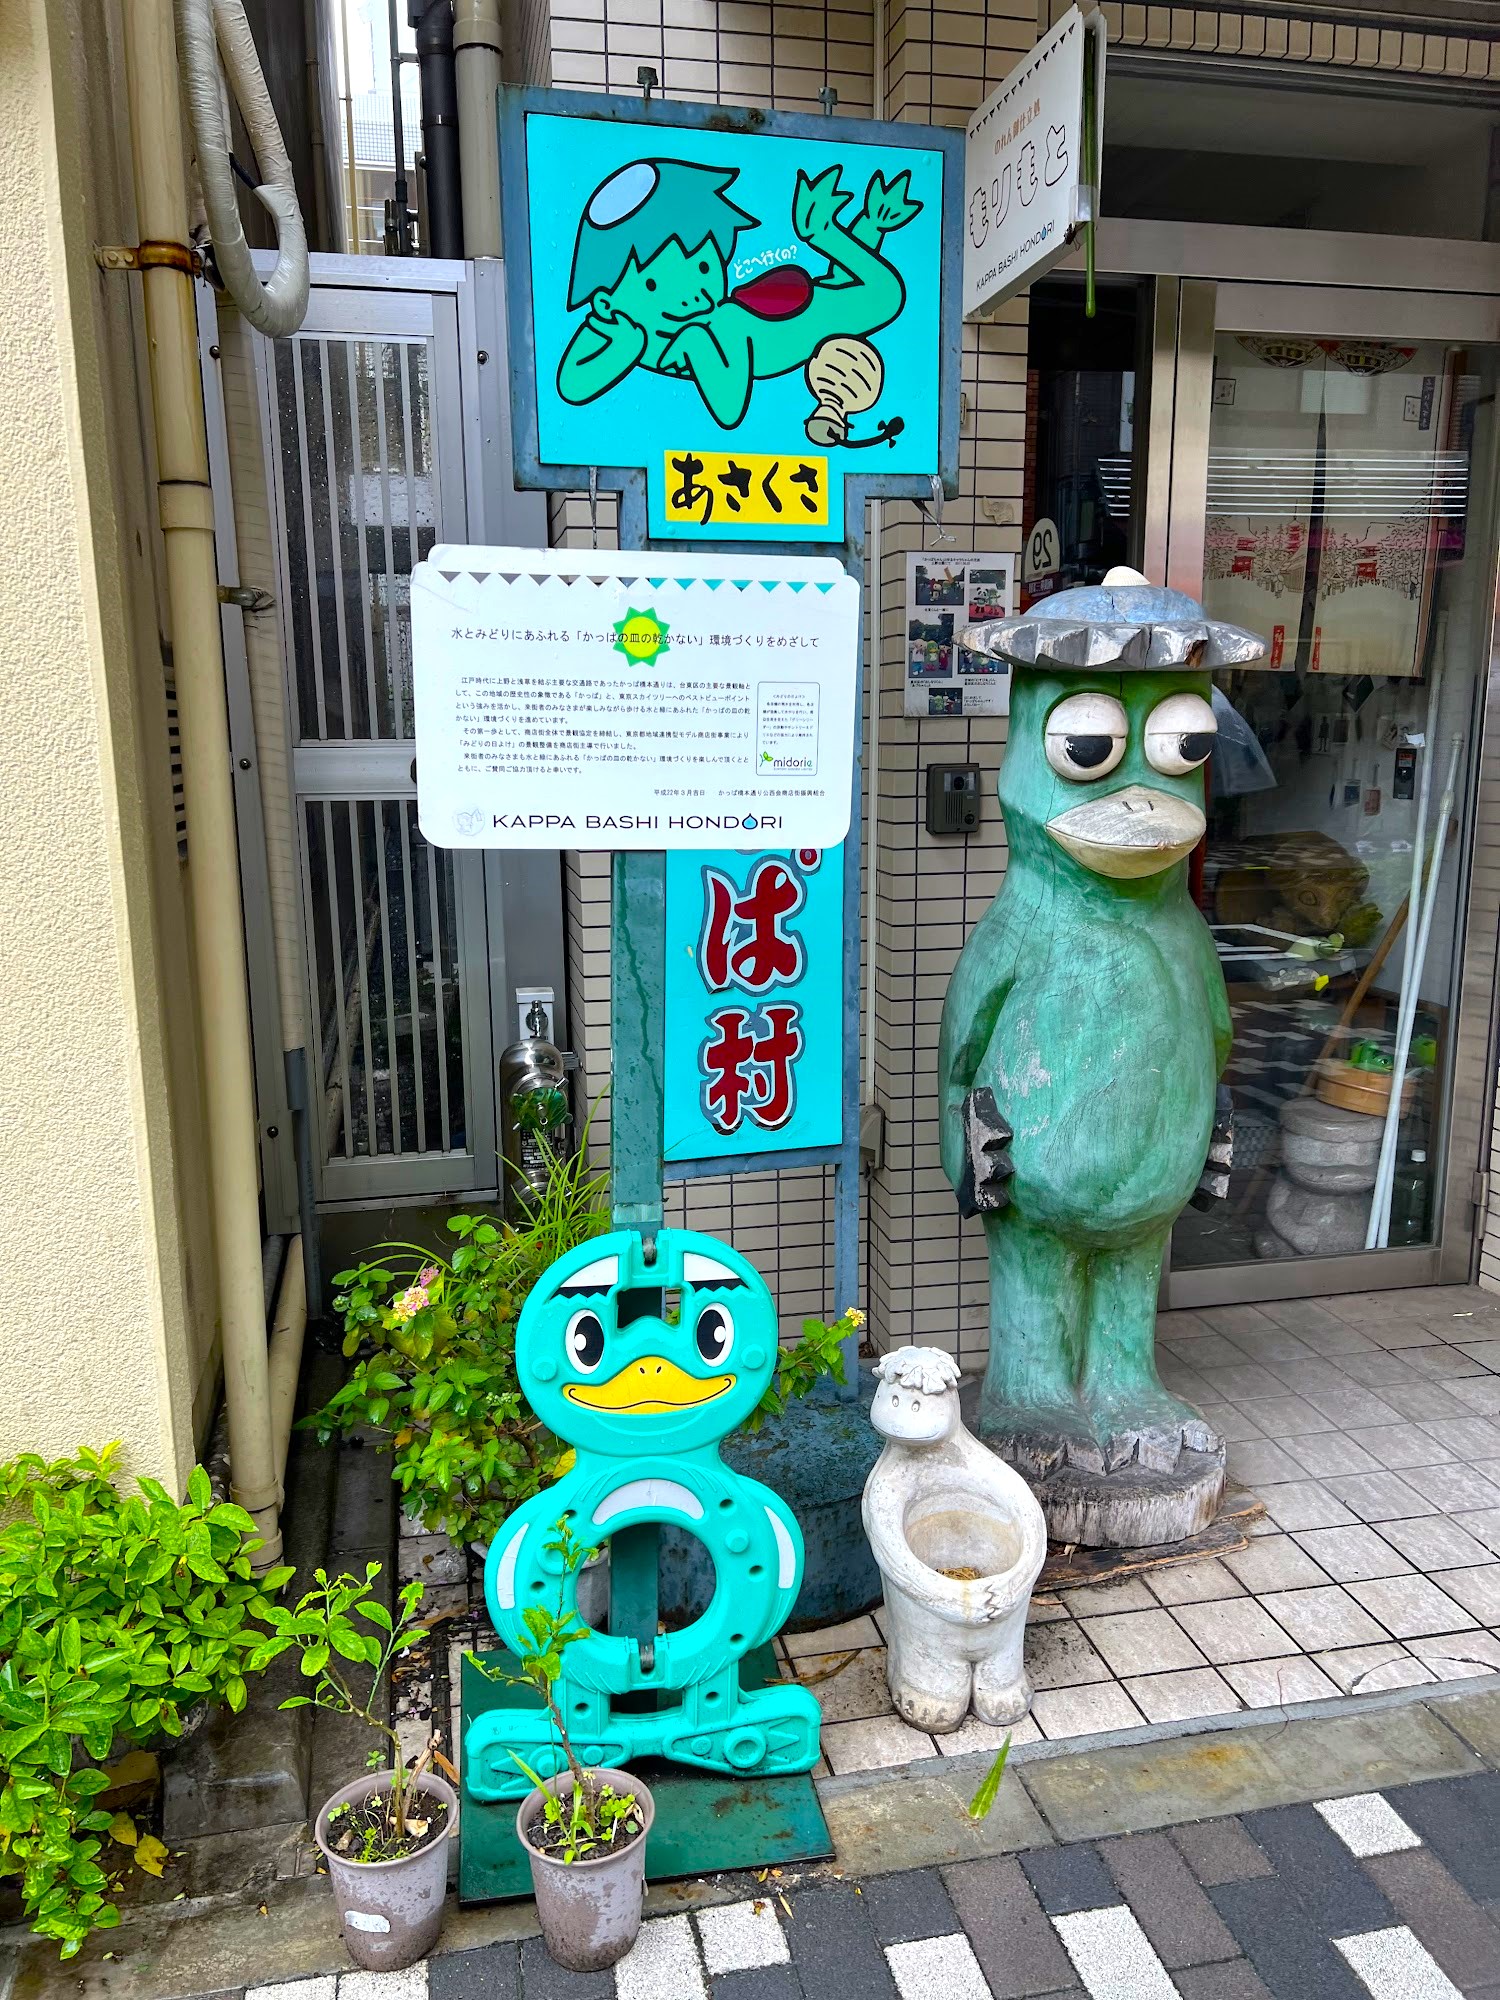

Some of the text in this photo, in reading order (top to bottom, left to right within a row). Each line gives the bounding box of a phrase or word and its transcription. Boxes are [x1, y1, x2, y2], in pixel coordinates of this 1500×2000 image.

[969, 125, 1069, 249] もりもと
[733, 244, 798, 279] どこへ行くの?
[976, 219, 1055, 292] KAPPA BASHI HONDORI
[670, 451, 819, 526] あさくさ
[773, 756, 813, 768] midorie
[493, 812, 783, 831] KAPPA BASHI HONDORI
[697, 849, 822, 1136] ぱ村
